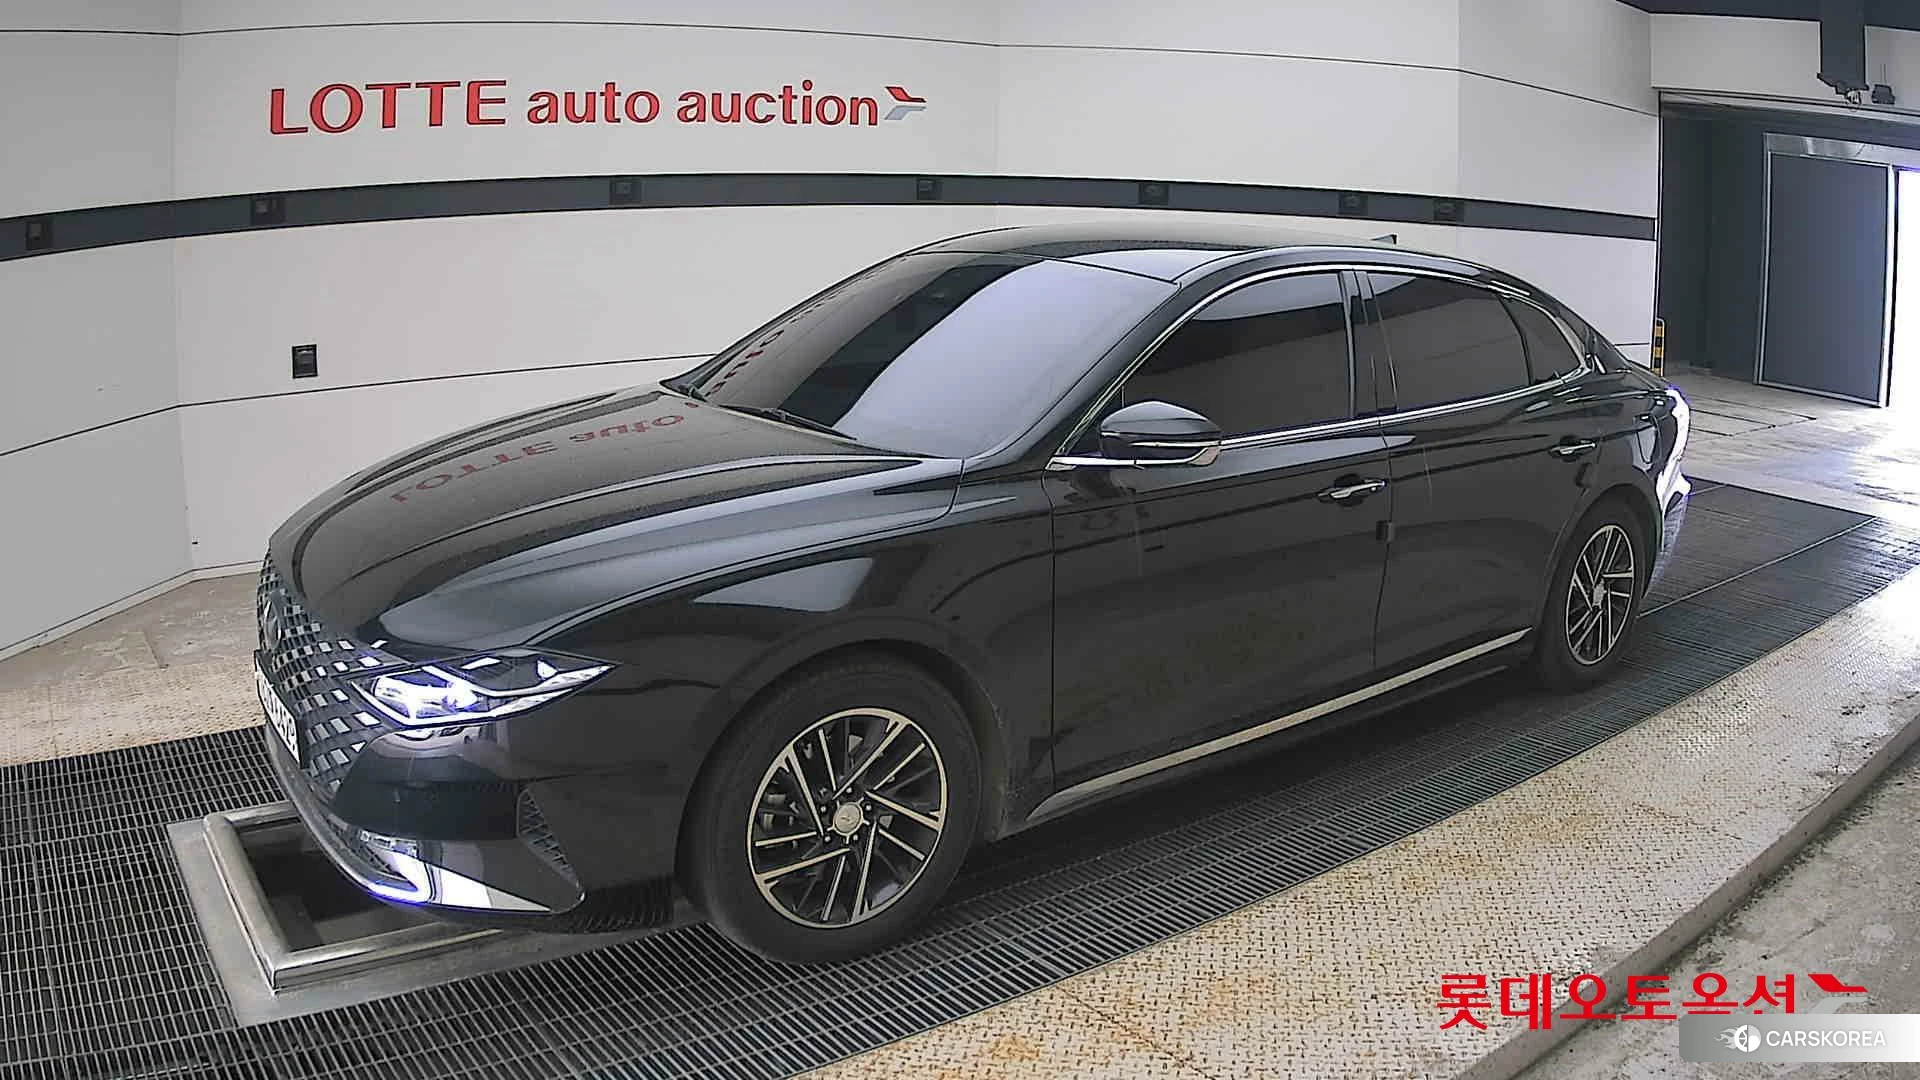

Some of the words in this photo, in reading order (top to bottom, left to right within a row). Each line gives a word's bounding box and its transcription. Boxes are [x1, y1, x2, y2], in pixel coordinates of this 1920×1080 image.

[269, 80, 506, 135] LOTTE
[526, 82, 660, 124] auto
[676, 81, 879, 126] auction
